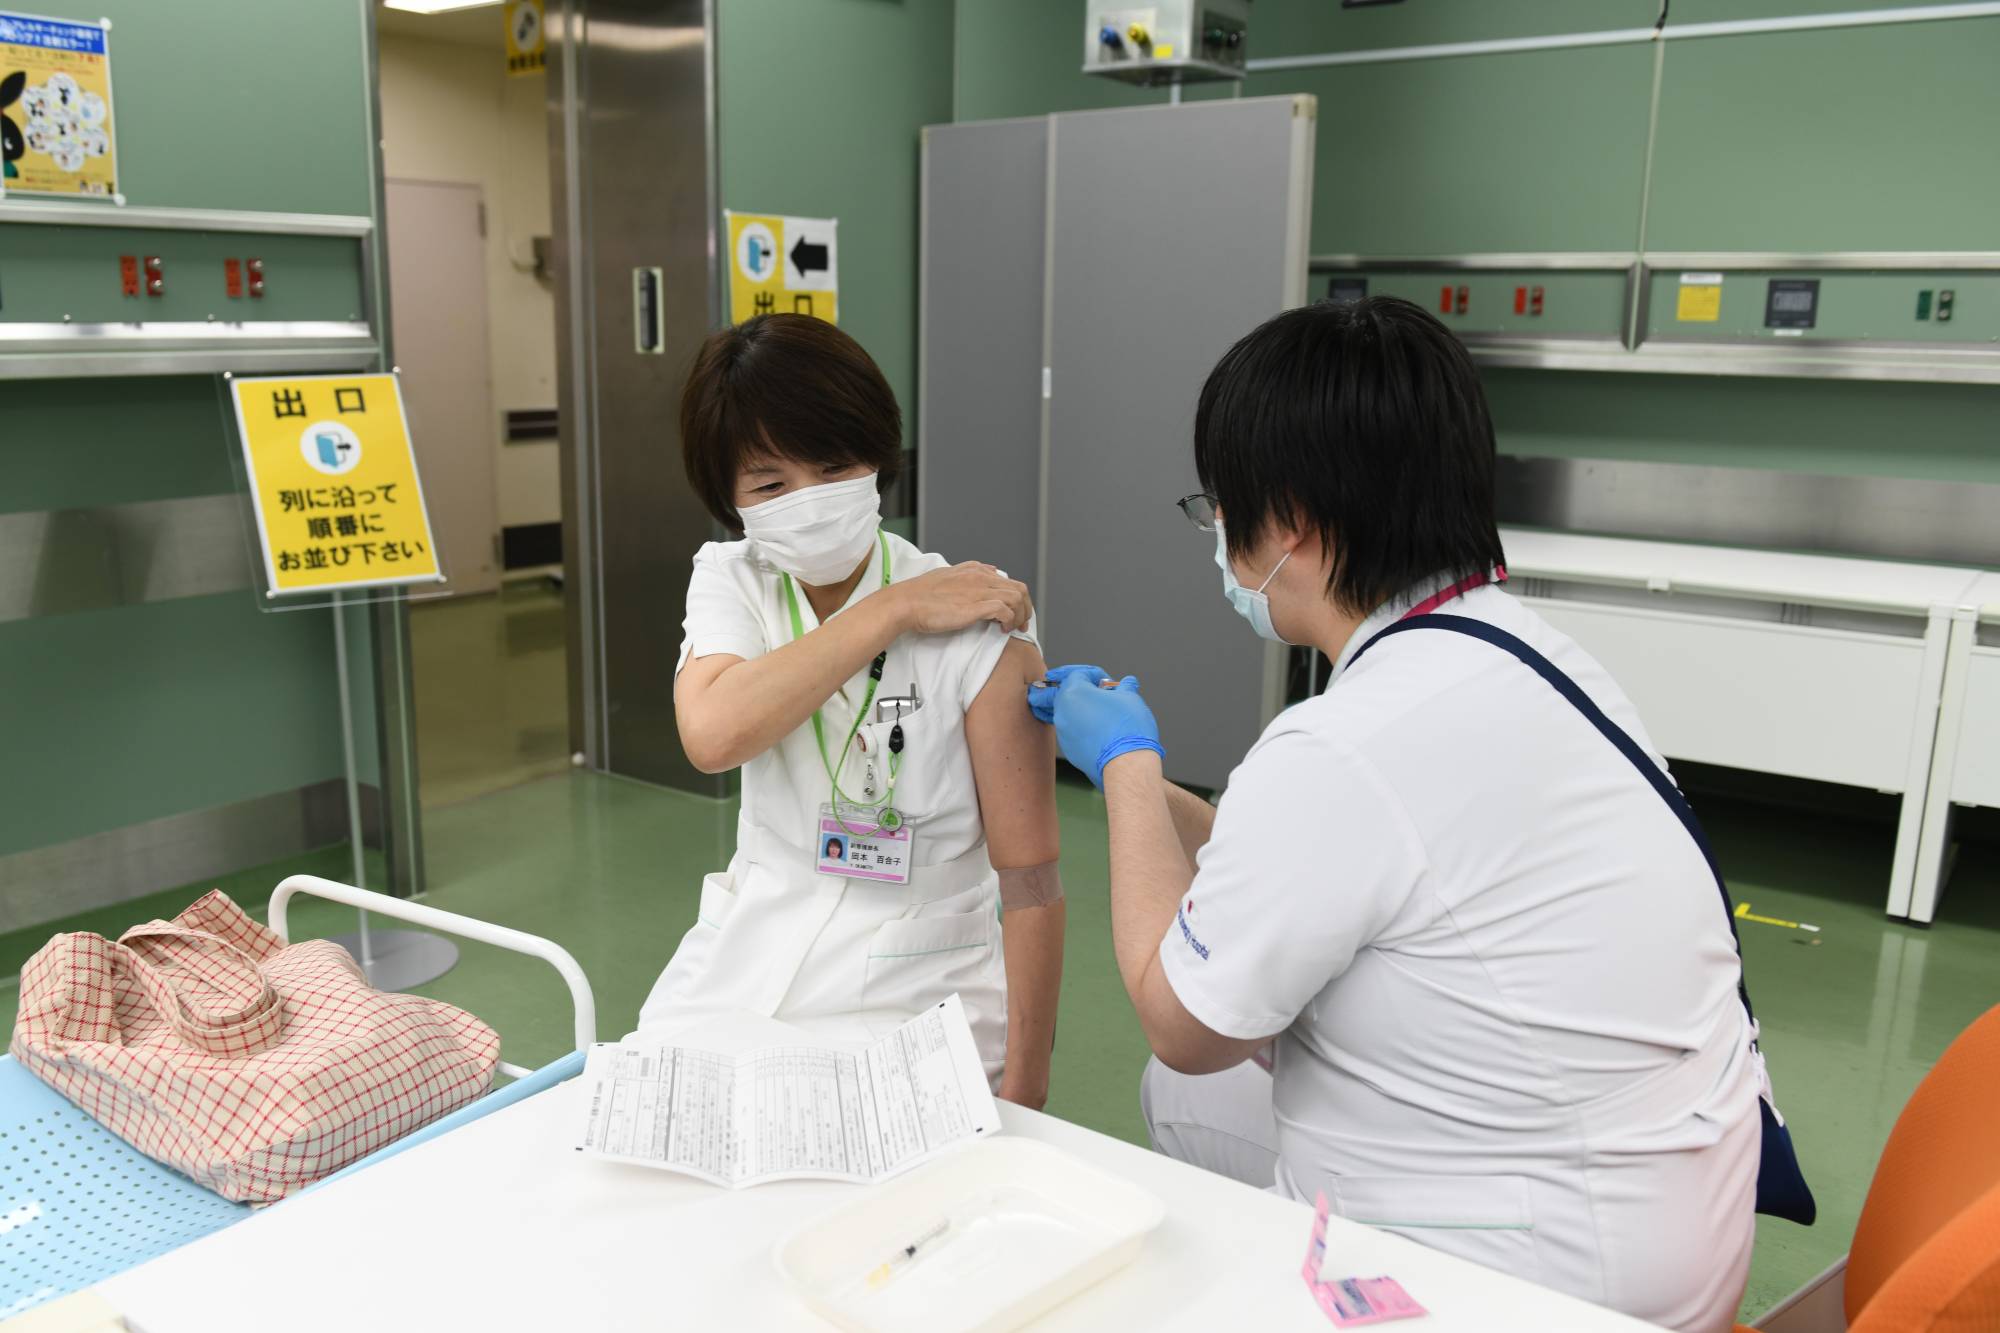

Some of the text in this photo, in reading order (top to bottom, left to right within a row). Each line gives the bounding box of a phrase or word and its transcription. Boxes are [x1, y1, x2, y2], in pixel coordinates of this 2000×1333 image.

[272, 387, 366, 419] 出口
[278, 483, 397, 512] 列に沿って
[307, 514, 384, 539] 順番に
[278, 541, 424, 572] お並び下さい
